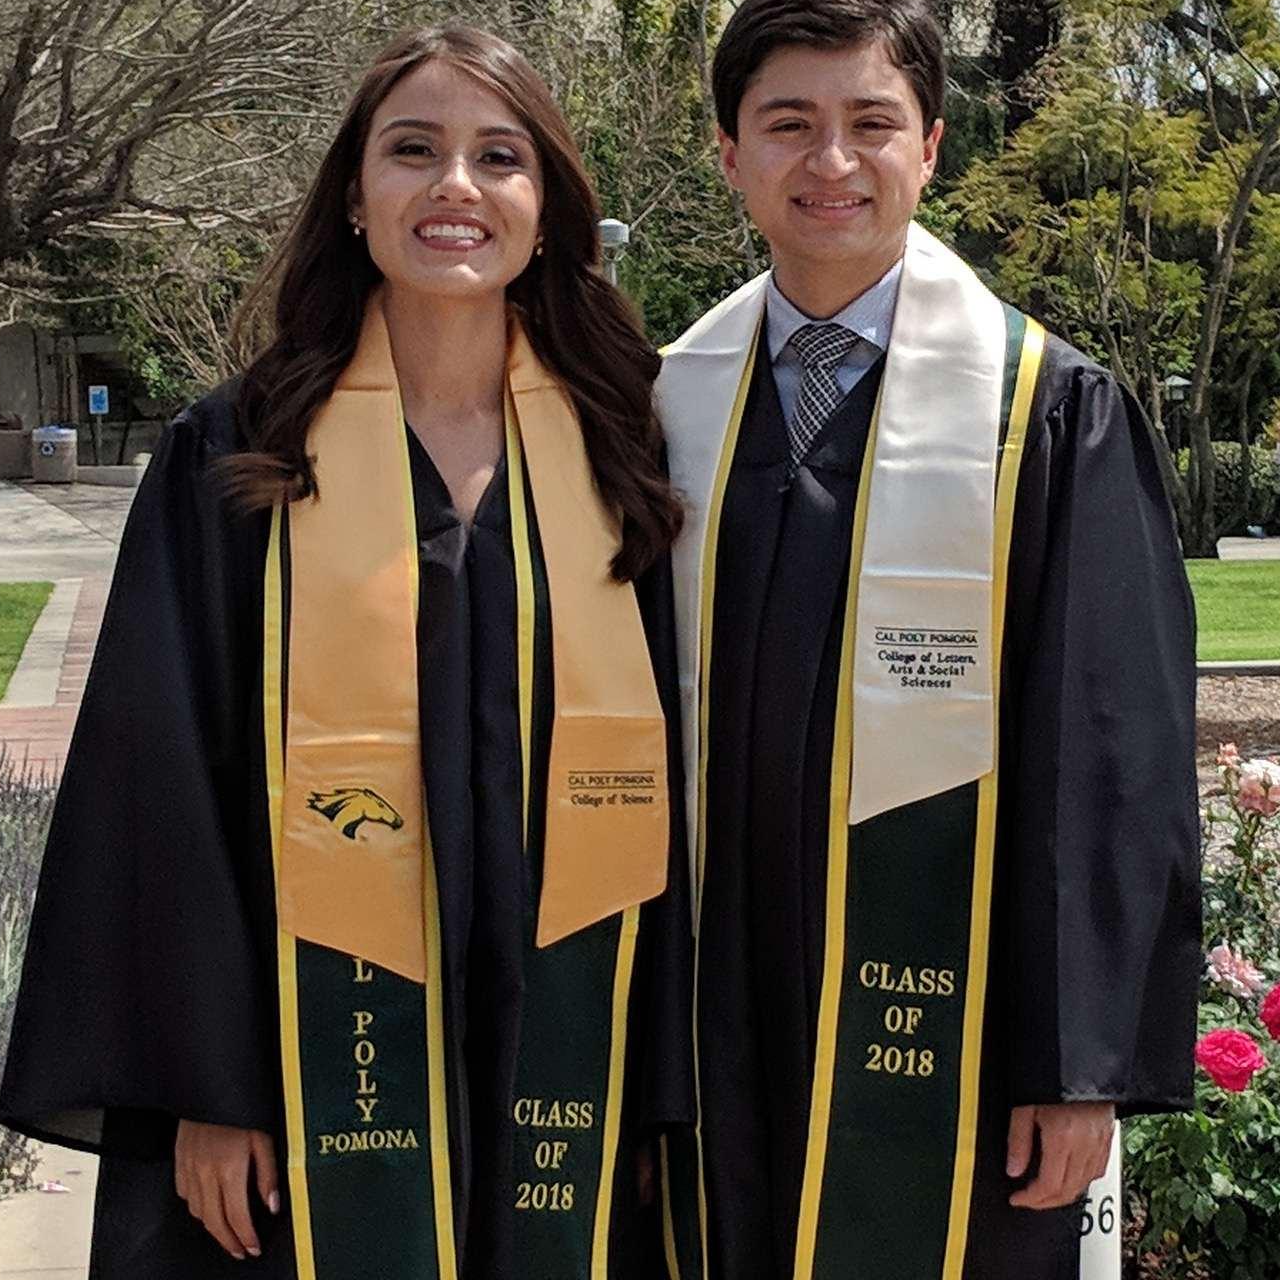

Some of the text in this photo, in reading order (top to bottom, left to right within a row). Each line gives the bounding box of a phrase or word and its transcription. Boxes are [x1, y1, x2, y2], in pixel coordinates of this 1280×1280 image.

[875, 632, 977, 644] CAL POLY POMONA
[878, 650, 976, 665] College of Letters,
[888, 664, 965, 676] Arts & Social
[901, 676, 951, 688] Sciences
[568, 775, 586, 785] CAL
[570, 794, 603, 807] College
[860, 961, 955, 995] CLASS
[884, 1005, 923, 1035] OF
[353, 1011, 379, 1122] POLY
[864, 1044, 935, 1077] 2018
[513, 1098, 594, 1129] CLASS
[318, 1128, 419, 1154] POMONA
[535, 1141, 569, 1169] OF
[514, 1182, 575, 1211] 2018
